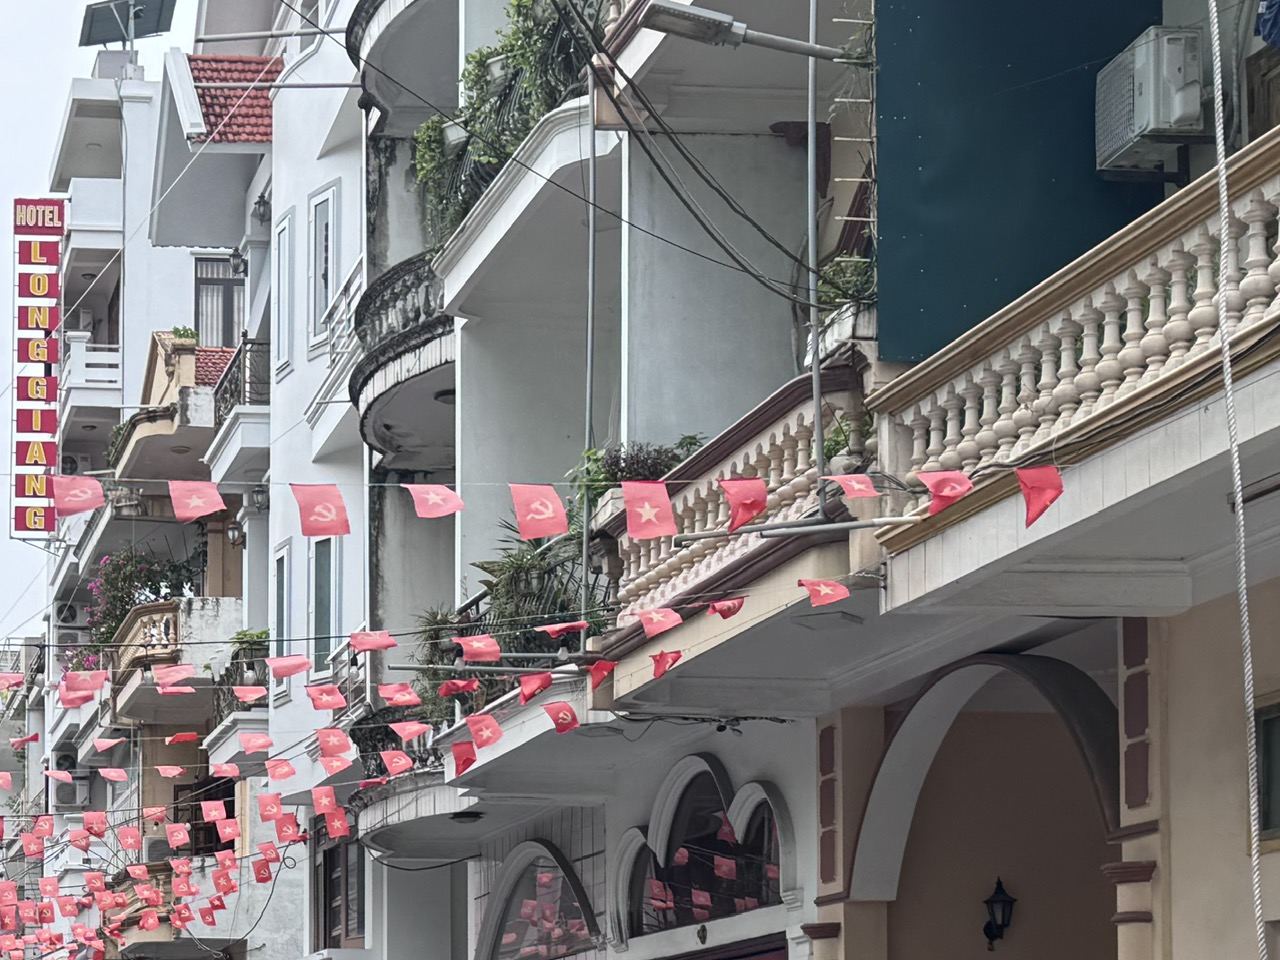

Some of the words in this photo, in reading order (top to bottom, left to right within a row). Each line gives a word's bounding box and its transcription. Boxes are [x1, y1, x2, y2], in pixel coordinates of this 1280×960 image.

[16, 204, 62, 228] HOTEL
[27, 241, 50, 362] LONG
[25, 377, 48, 530] GIANG
